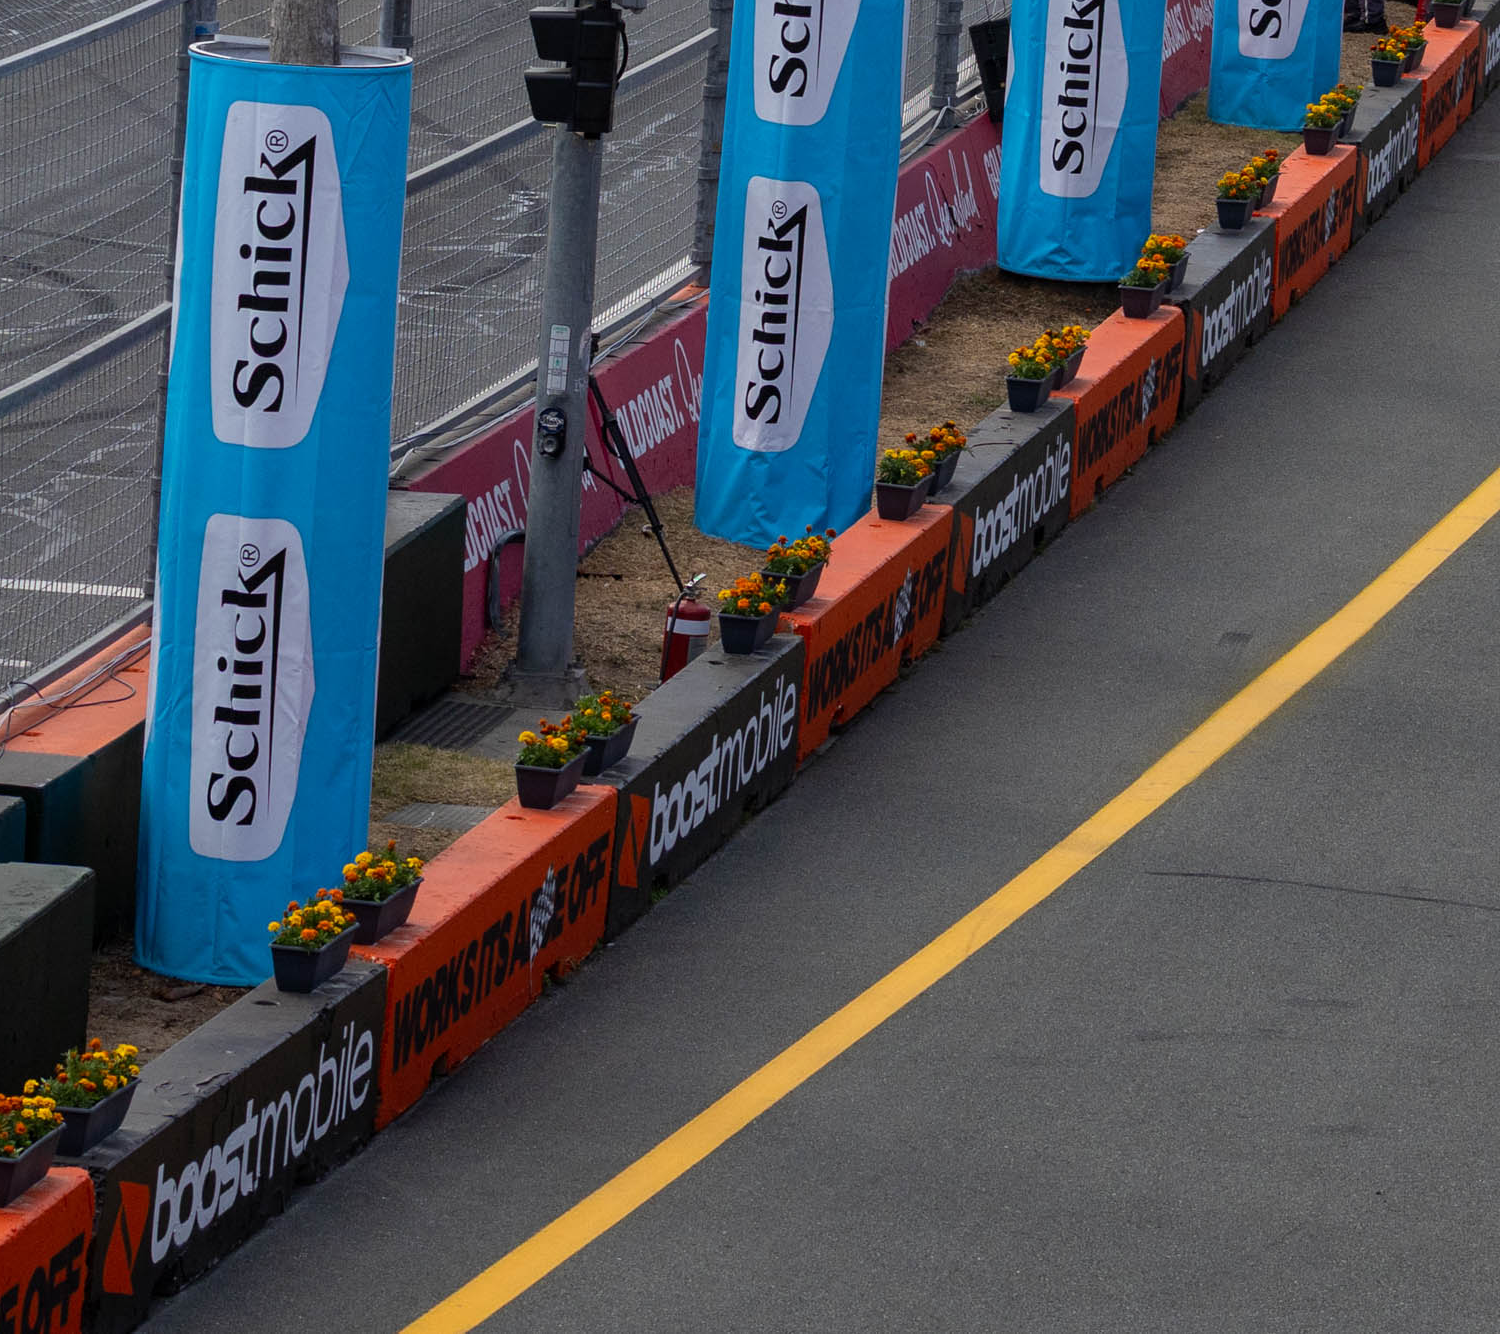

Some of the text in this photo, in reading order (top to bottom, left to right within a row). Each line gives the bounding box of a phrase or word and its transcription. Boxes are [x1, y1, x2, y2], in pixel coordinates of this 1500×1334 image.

[1201, 250, 1272, 368] boostmobile
[972, 433, 1072, 577] boostmobile
[648, 673, 797, 867] boostmobile
[392, 834, 610, 1074] WORKS ITS OFF
[151, 1020, 374, 1266] boostmobile
